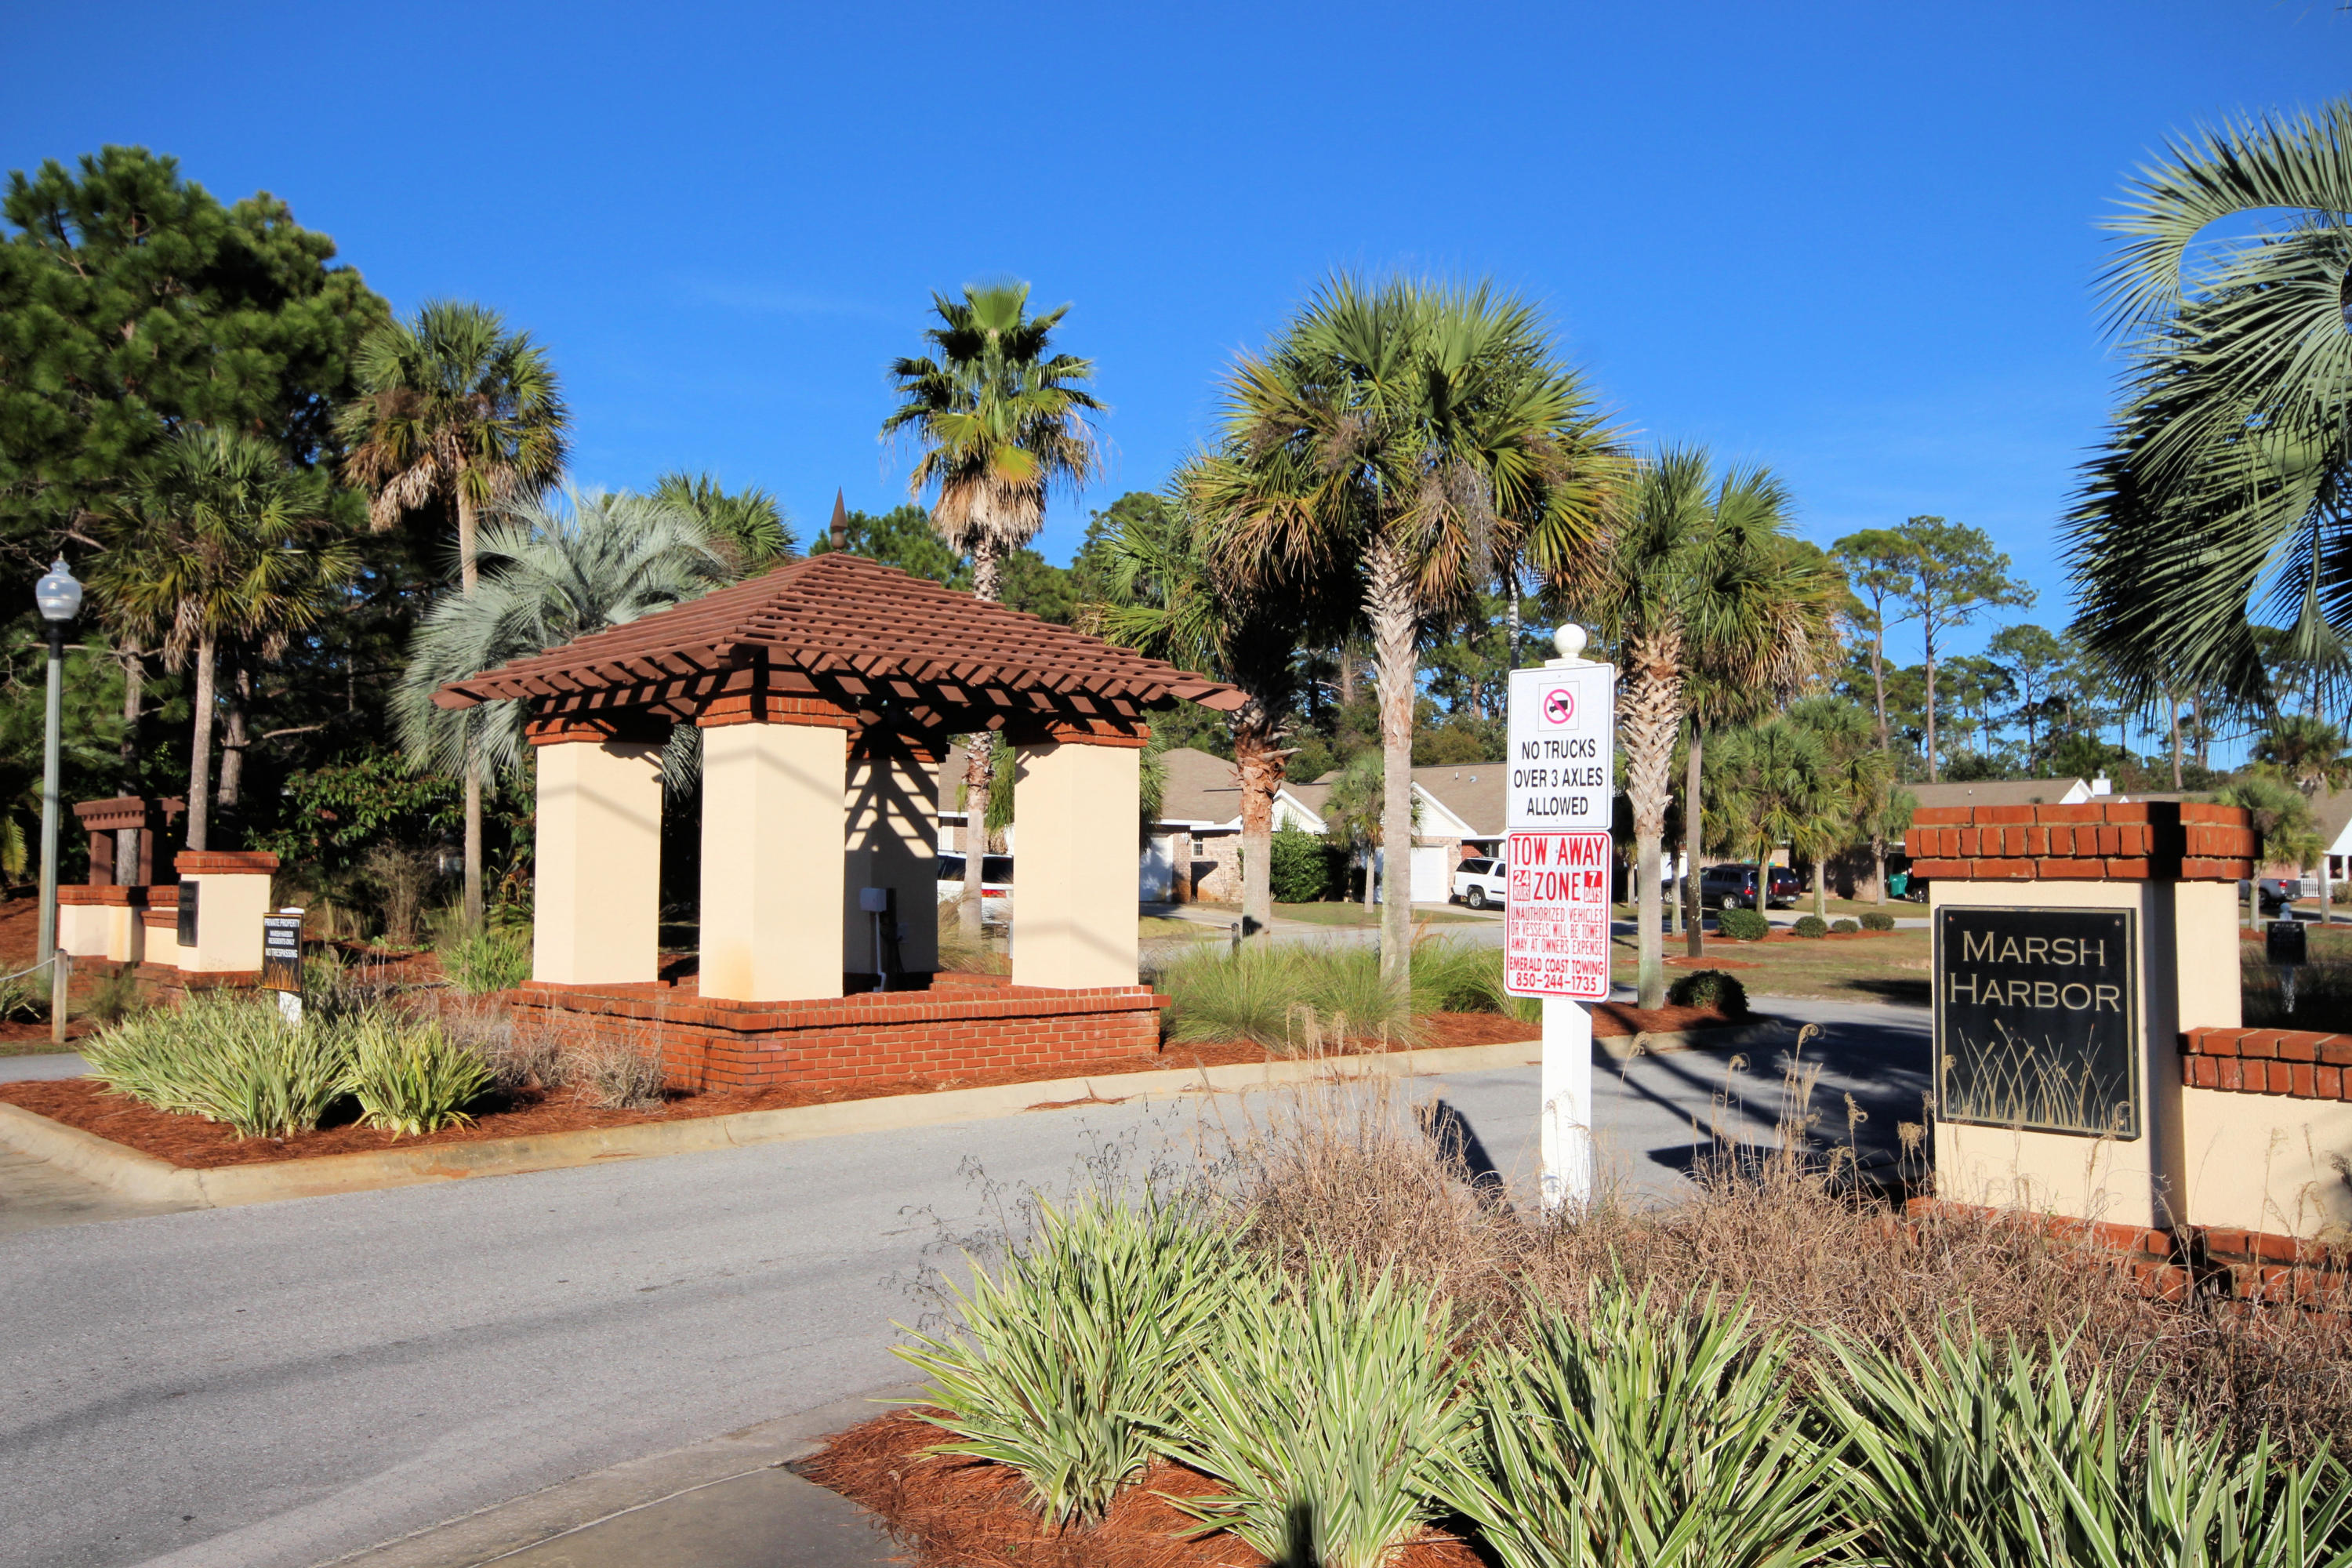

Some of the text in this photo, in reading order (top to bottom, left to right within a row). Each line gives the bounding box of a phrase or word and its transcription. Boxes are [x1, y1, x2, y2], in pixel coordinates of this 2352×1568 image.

[1522, 739, 1595, 760] NO TRUCKS
[1514, 767, 1602, 788] OVER 3 AXLES
[1526, 797, 1588, 816] ALLOWED
[1512, 837, 1605, 866] TOW AWAY
[1513, 872, 1530, 885] 24
[1534, 872, 1581, 901] ZONE
[1589, 872, 1597, 886] 7
[1513, 886, 1530, 901] HOURS
[1585, 887, 1602, 902] DAYS
[1511, 906, 1604, 923] UNAUTHORIZED VEHICLES
[1511, 922, 1603, 939] OR VESSELS WILL BE TOWED
[1511, 938, 1603, 956] AWAY AT OWNERS EXPENSE
[1962, 931, 2107, 967] MARSH
[1509, 956, 1604, 975] EMERALD COAST TOWING
[1515, 972, 1597, 992] 850-244-1735
[1950, 972, 2121, 1013] HARBOR
